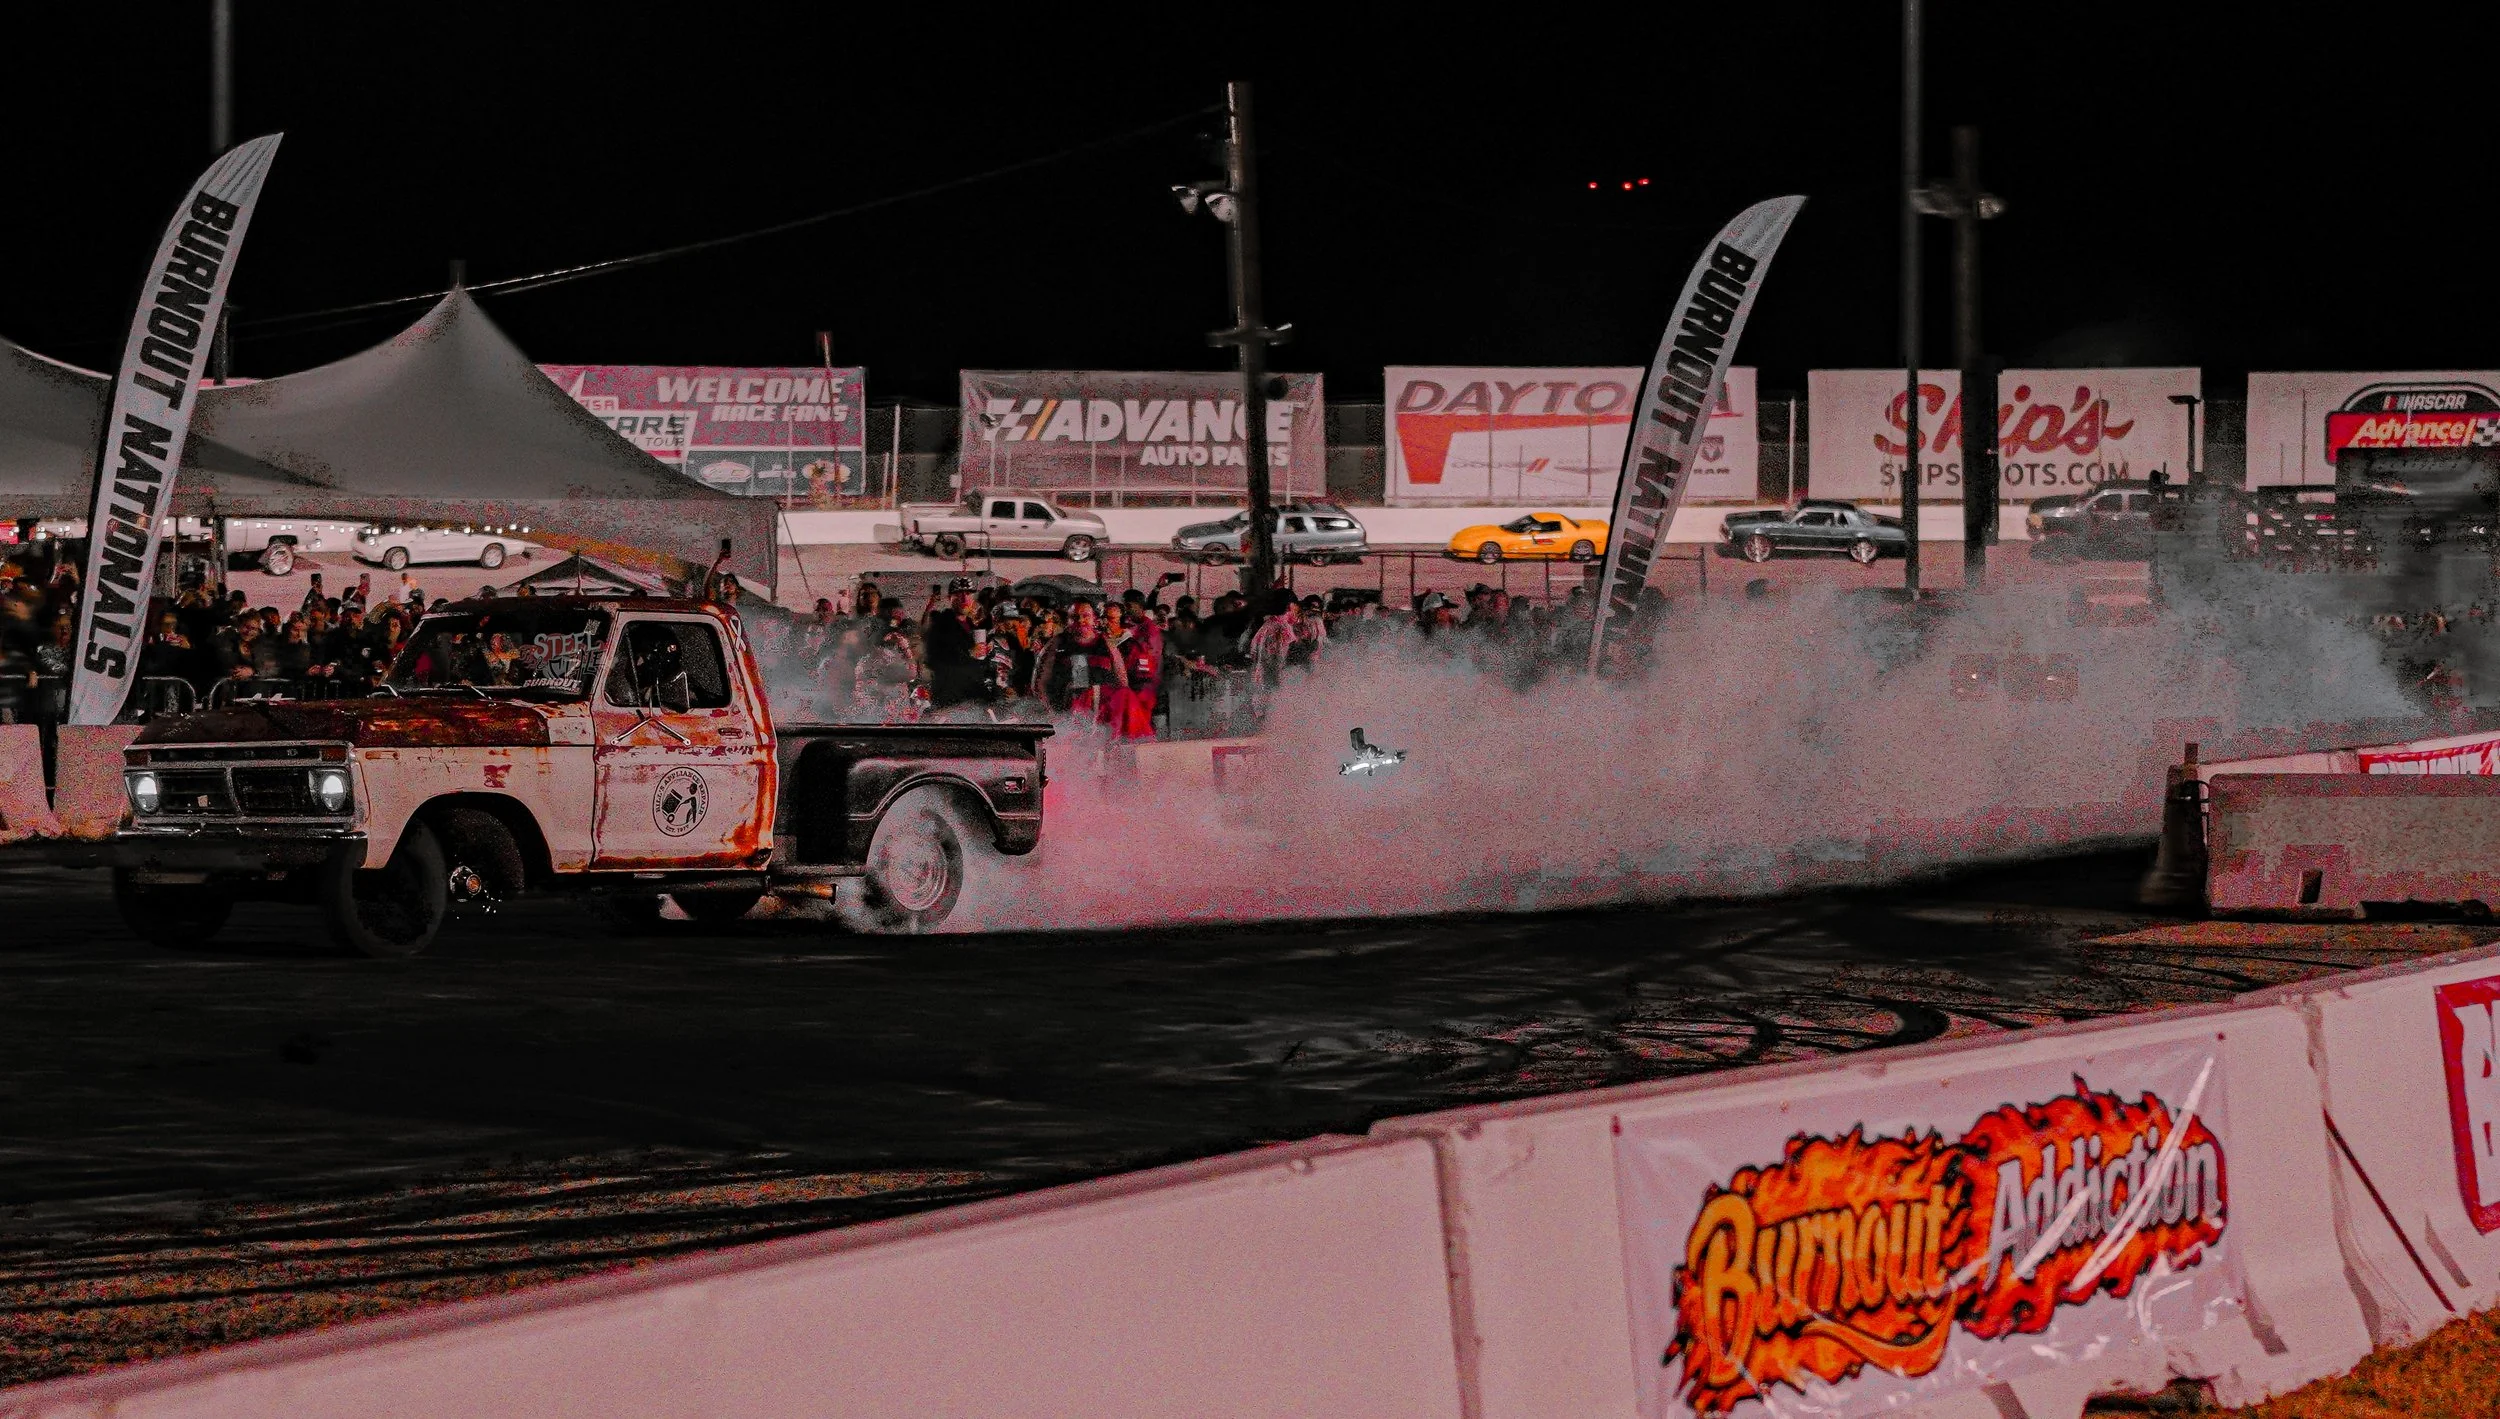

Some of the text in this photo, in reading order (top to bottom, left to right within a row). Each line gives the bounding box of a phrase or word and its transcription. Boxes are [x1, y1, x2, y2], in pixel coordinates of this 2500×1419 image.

[1650, 240, 1758, 444] BURNOUT
[656, 376, 846, 404] WELCOME
[2403, 392, 2468, 411] NASCAR
[710, 404, 850, 424] RACE FANS
[83, 190, 241, 681] BURNOUT NATIONALS
[2347, 417, 2466, 446] Advance
[1139, 446, 1210, 467] AUTO
[533, 631, 601, 661] STEEL
[1686, 1126, 2226, 1389] Burnout Addiction
